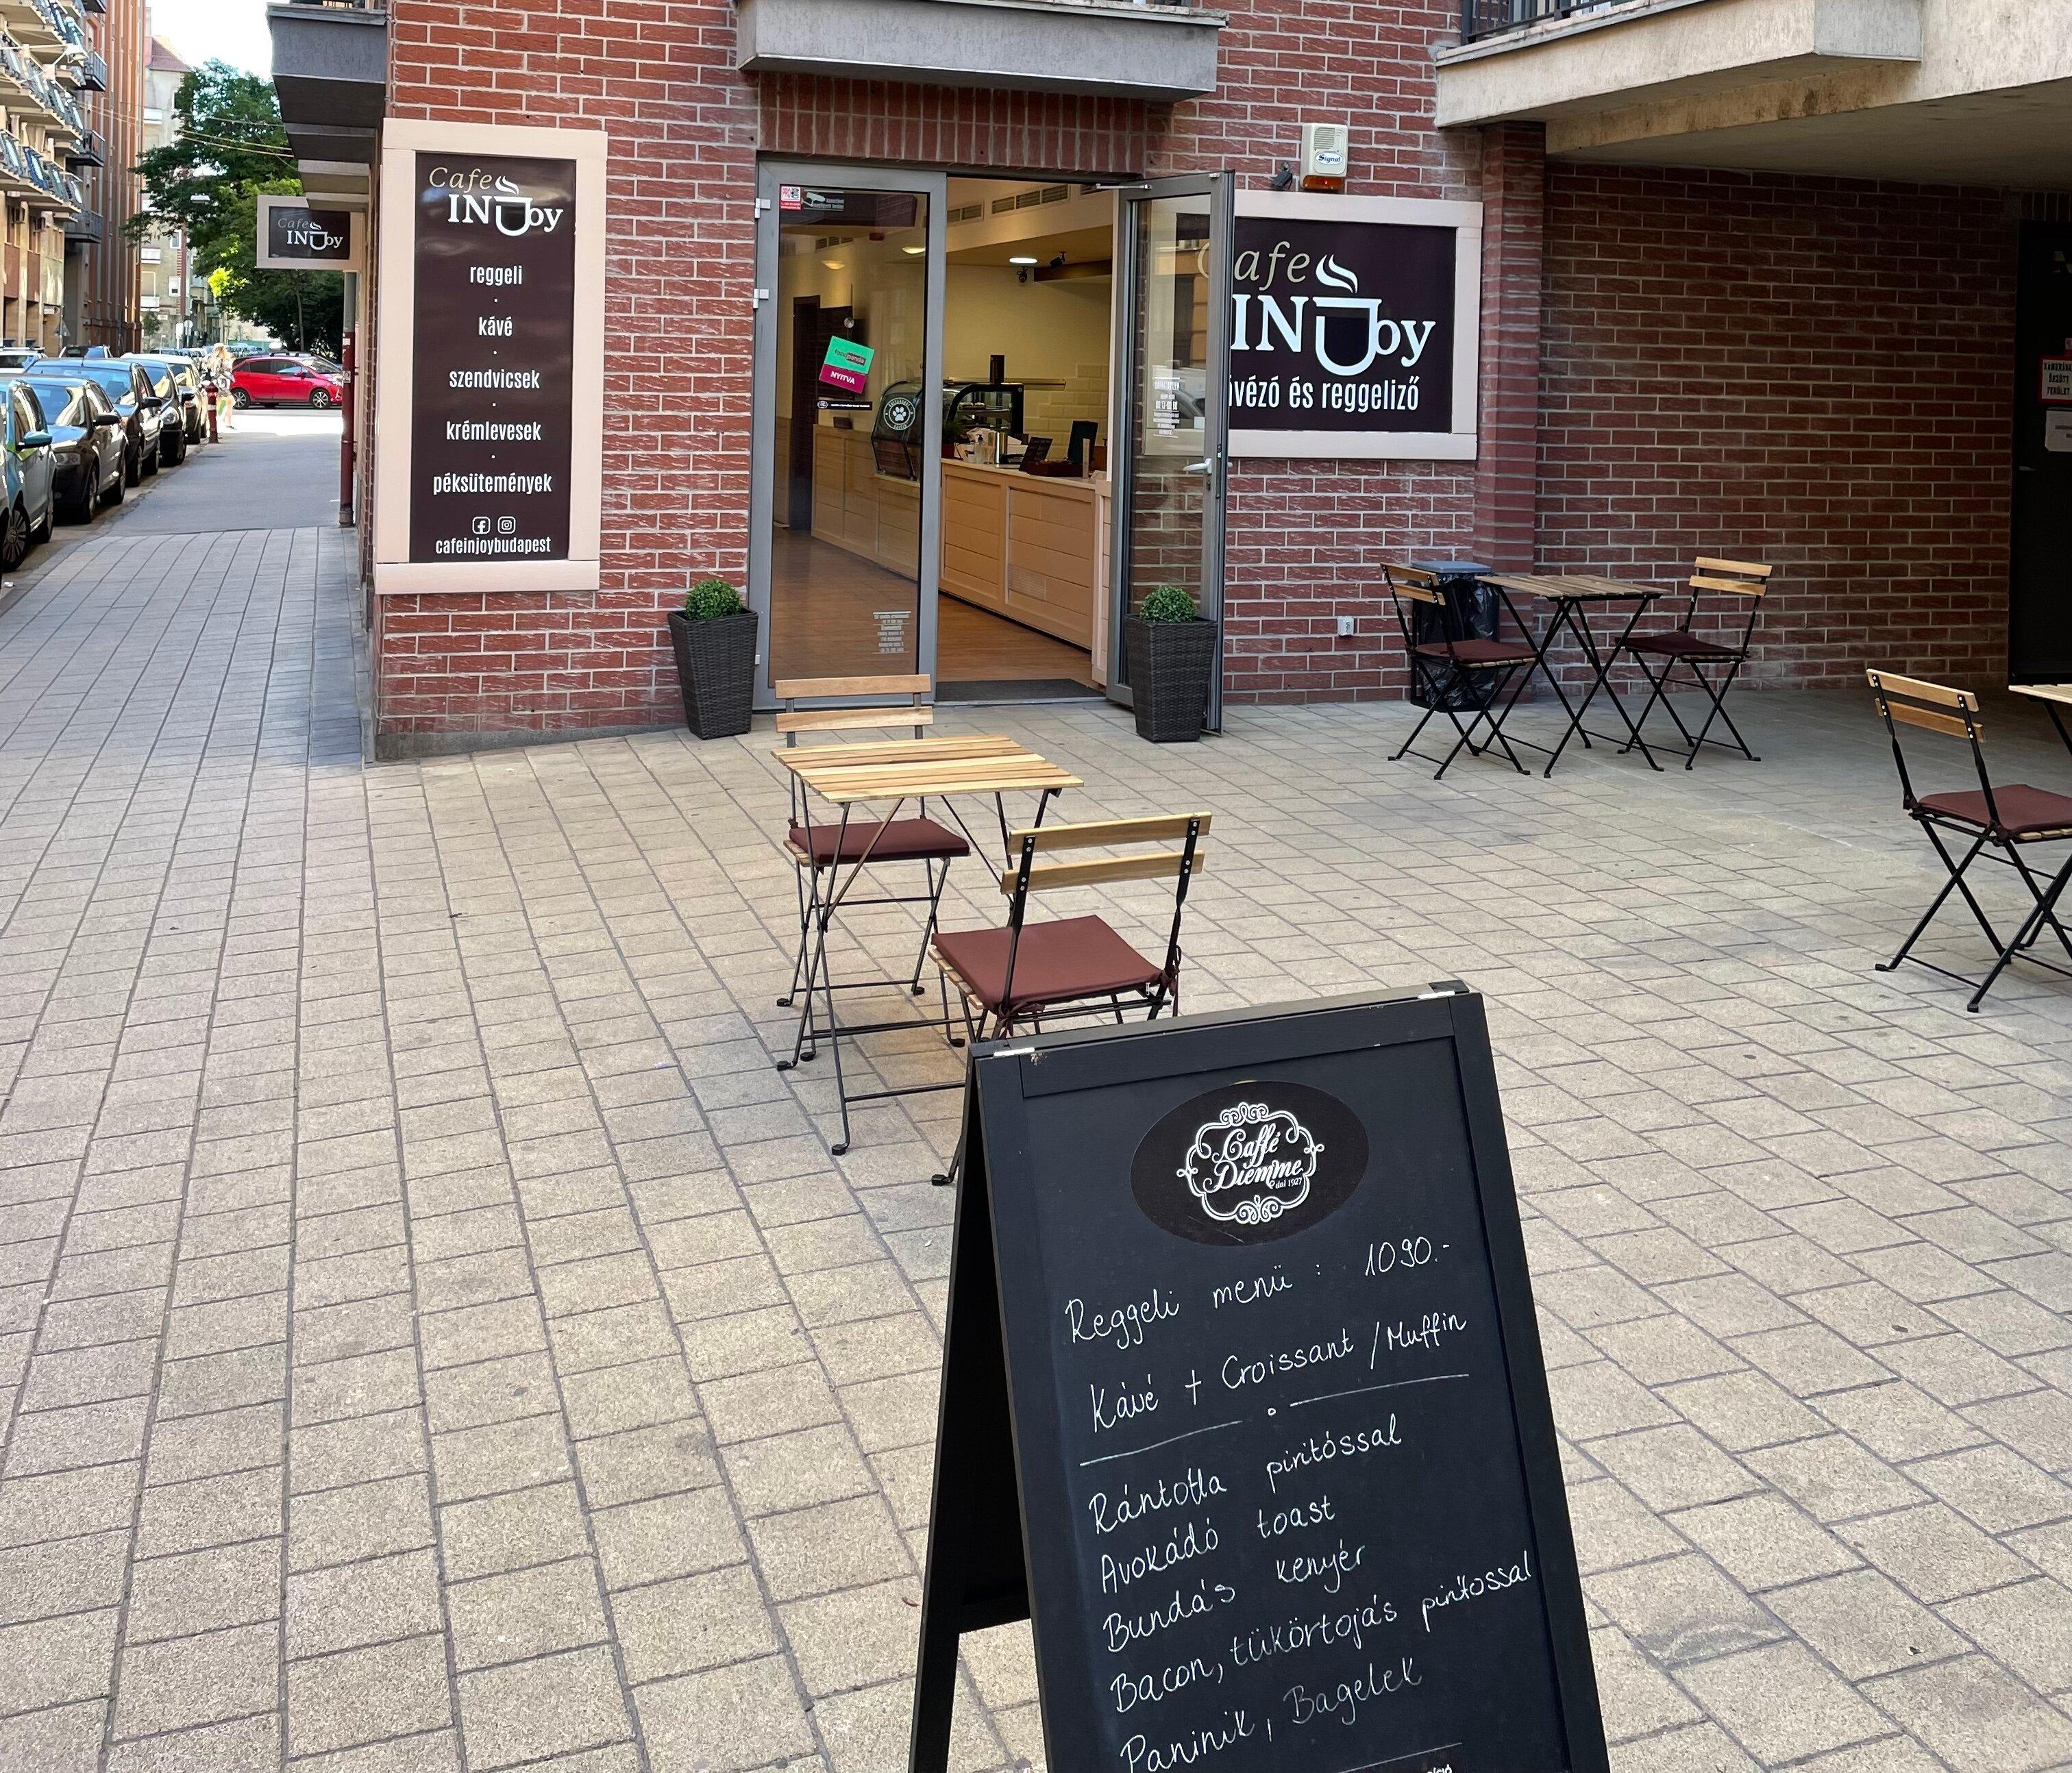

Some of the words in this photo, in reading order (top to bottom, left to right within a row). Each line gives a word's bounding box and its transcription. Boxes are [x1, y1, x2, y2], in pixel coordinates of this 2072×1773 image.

[1318, 153, 1341, 164] Signal
[429, 166, 493, 194] Cafe
[278, 217, 309, 230] Cafe
[469, 265, 523, 286] reggeli
[478, 316, 513, 337] kávé
[449, 369, 540, 389] szendvicsek
[830, 371, 855, 385] NYITVA
[1289, 375, 1314, 409] és
[1322, 375, 1420, 413] reggeliző
[446, 419, 541, 441] krémlevesek
[433, 472, 552, 495] péksütemények
[435, 536, 551, 556] cafeinjoybudapest
[1202, 1159, 1304, 1193] Diemme
[1275, 1178, 1287, 1189] dal
[1288, 1177, 1303, 1187] 1927
[1065, 1289, 1180, 1350] Reggeli
[1213, 1264, 1293, 1309] menü
[1089, 1373, 1159, 1433] Kávé
[1222, 1328, 1355, 1389] Croissant
[1101, 1517, 1218, 1594] Avokádó
[1257, 1494, 1336, 1539] toast
[1102, 1578, 1235, 1652] Bundás
[1276, 1538, 1366, 1594] kenyér
[1110, 1658, 1223, 1713] Bacon,
[1230, 1594, 1398, 1667] tükörtojás
[1283, 1657, 1422, 1726] Bagelek
